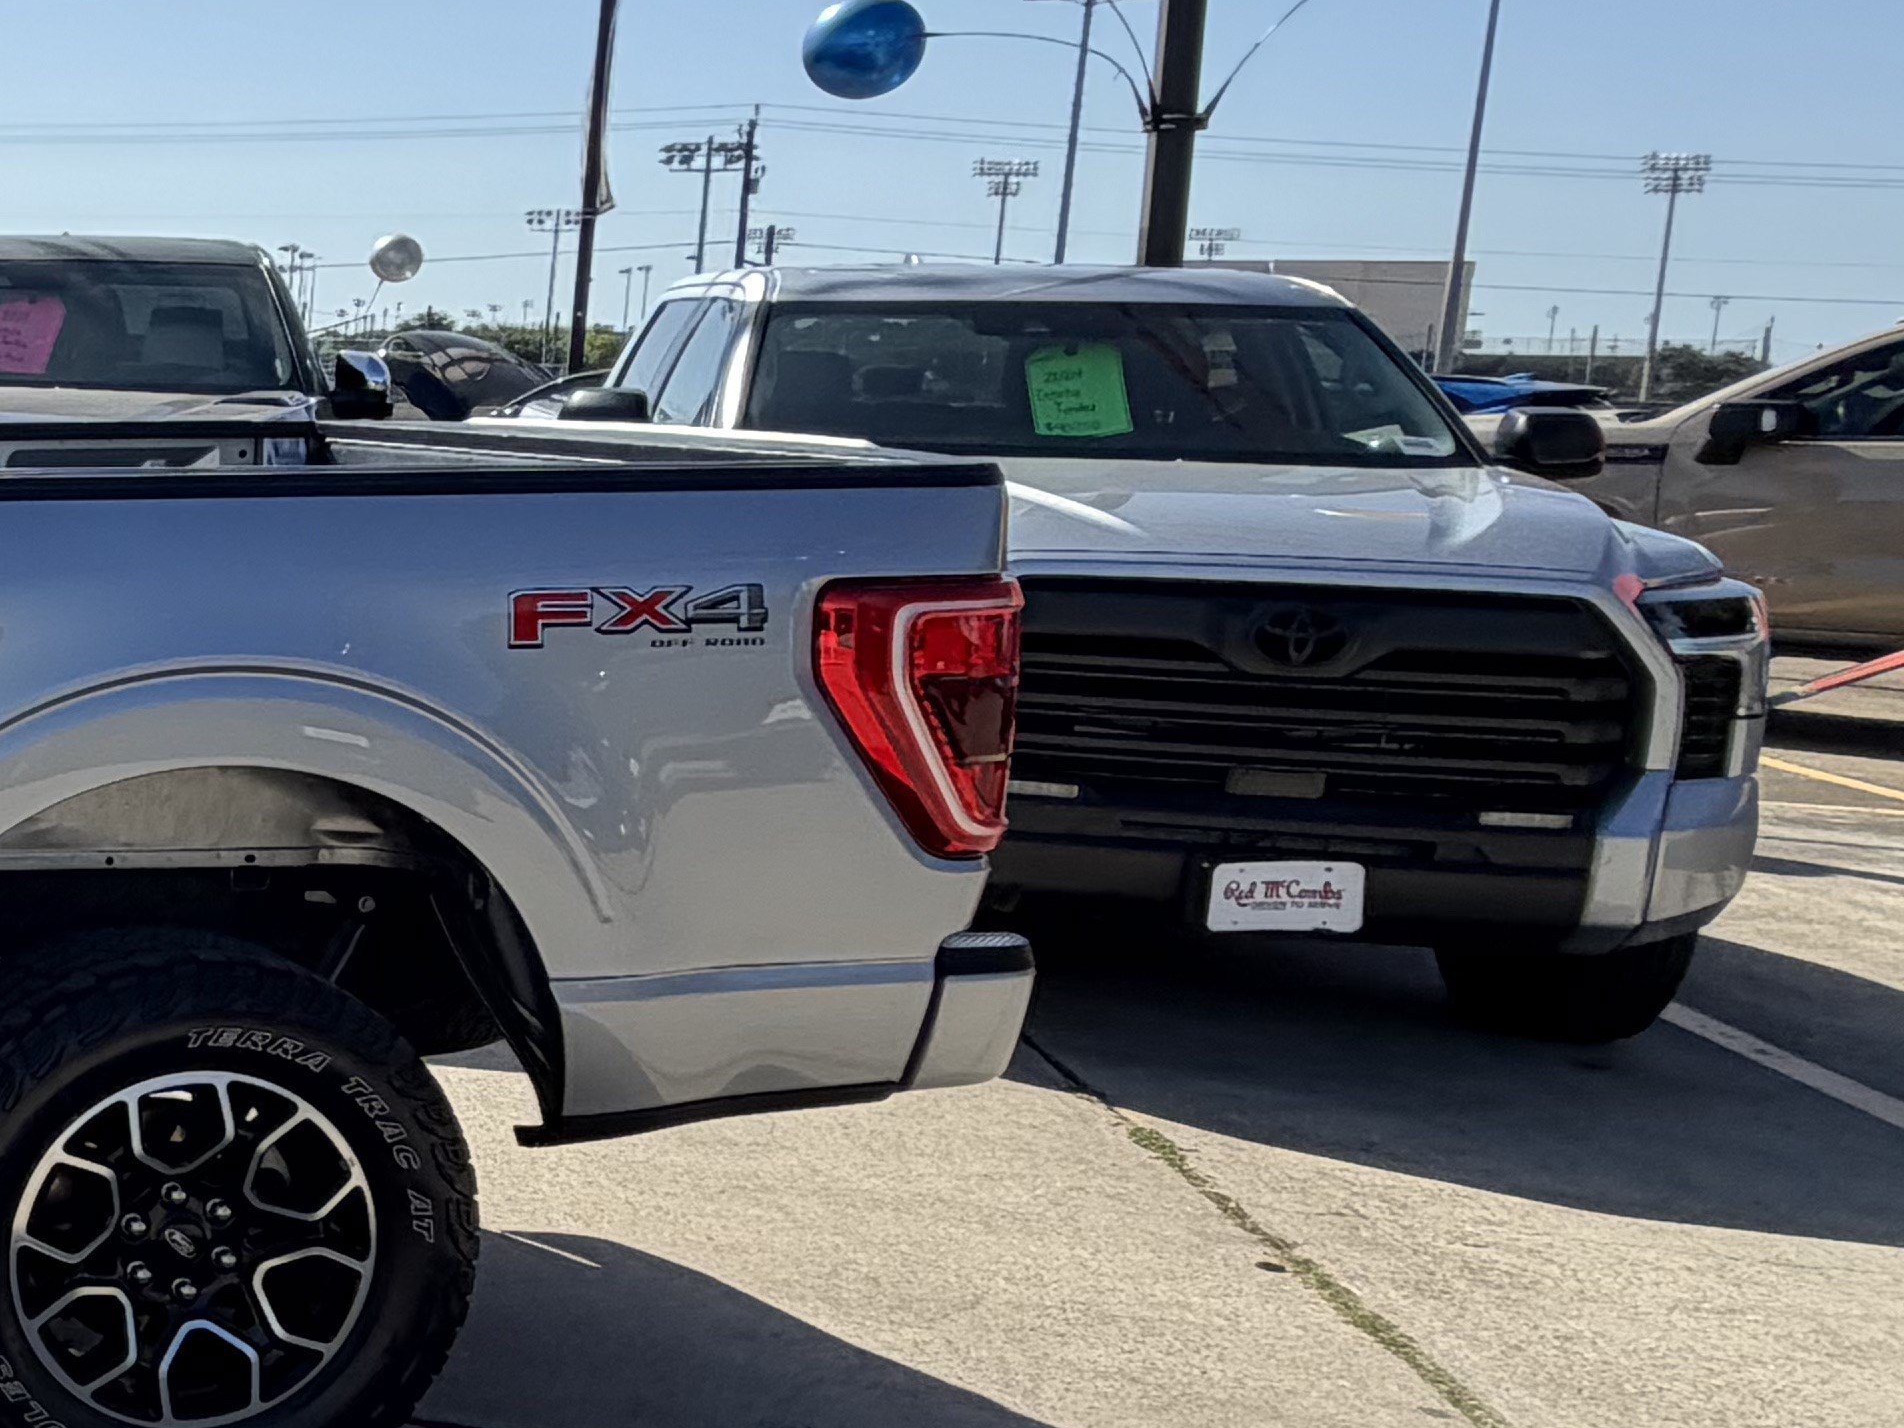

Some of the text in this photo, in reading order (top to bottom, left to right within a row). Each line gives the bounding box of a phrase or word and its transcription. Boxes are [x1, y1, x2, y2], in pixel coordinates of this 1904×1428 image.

[508, 583, 769, 649] FX4
[650, 636, 766, 648] OFF ROAD
[1223, 879, 1345, 907] Red McCombs
[188, 1027, 435, 1244] TERRA TRAC AT
